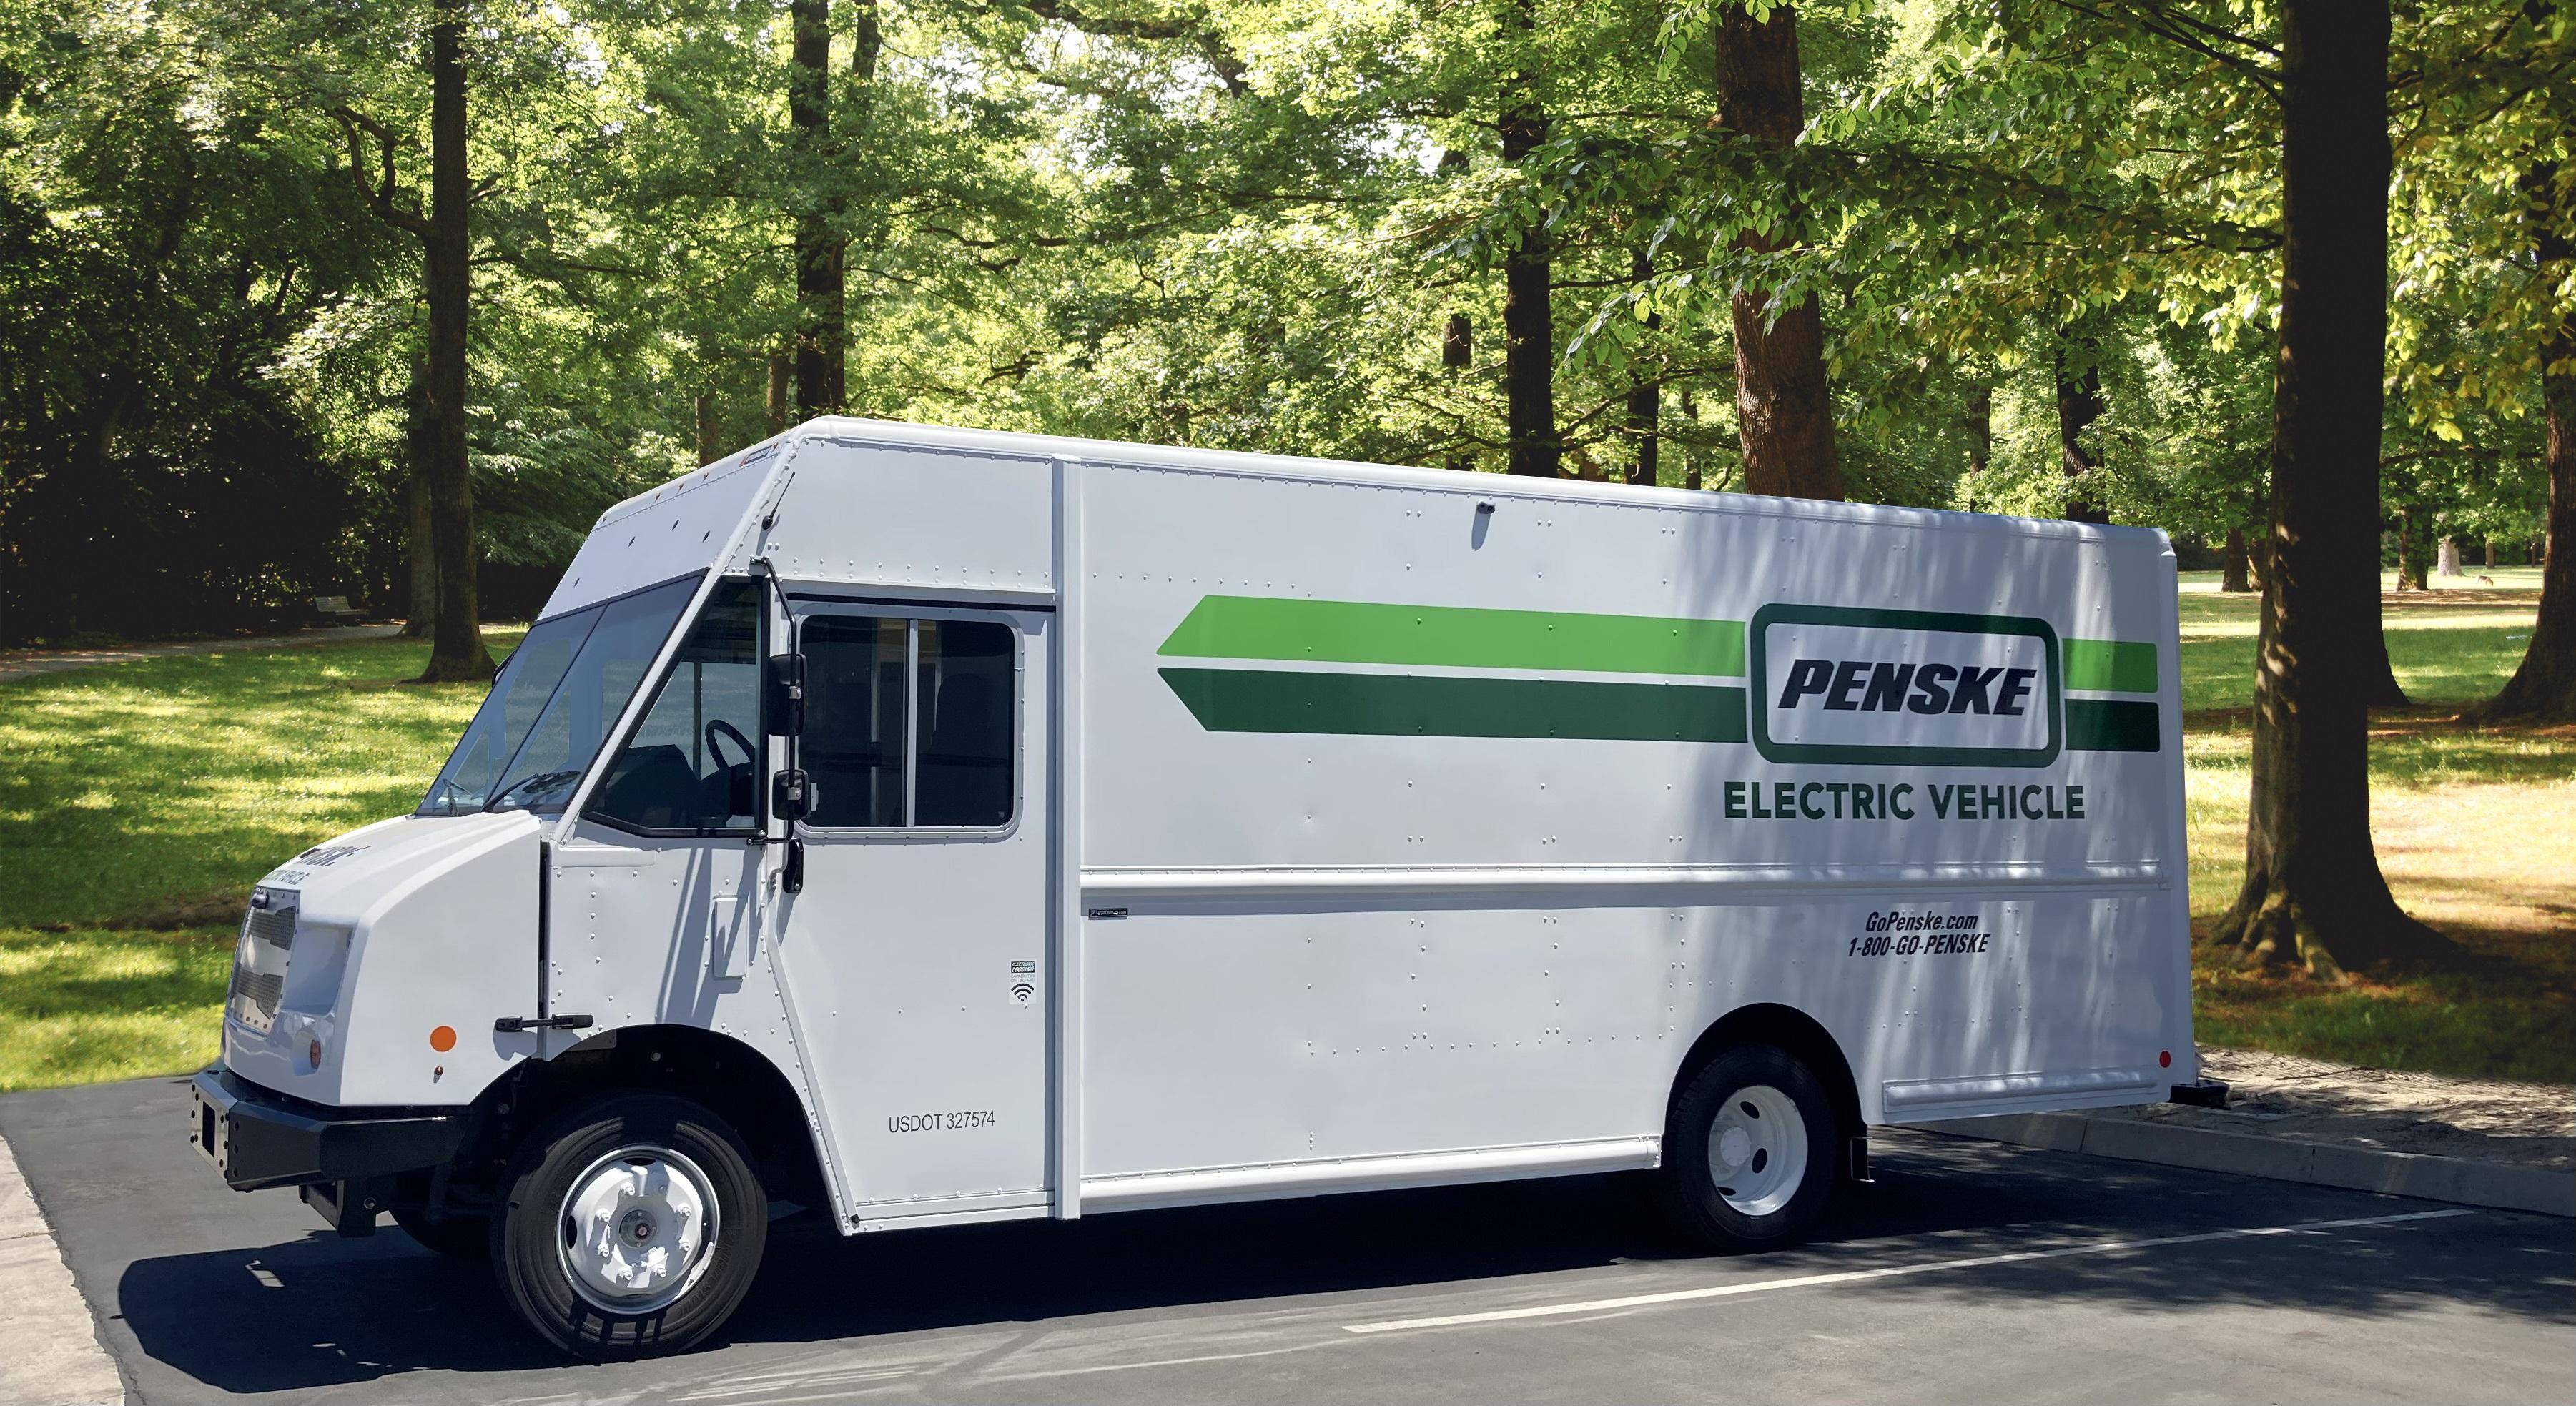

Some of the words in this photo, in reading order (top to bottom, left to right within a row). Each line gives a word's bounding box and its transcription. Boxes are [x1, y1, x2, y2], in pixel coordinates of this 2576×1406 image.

[1777, 659, 2037, 716] PENSKE
[1724, 781, 1915, 821] ELECTRIC
[1928, 784, 2086, 821] VEHICLE
[1865, 911, 1978, 932] GoPenske.com
[1848, 933, 1991, 956] 1-800-GO-PENSKE
[889, 1113, 943, 1133] USDOT
[946, 1110, 995, 1129] 327574
